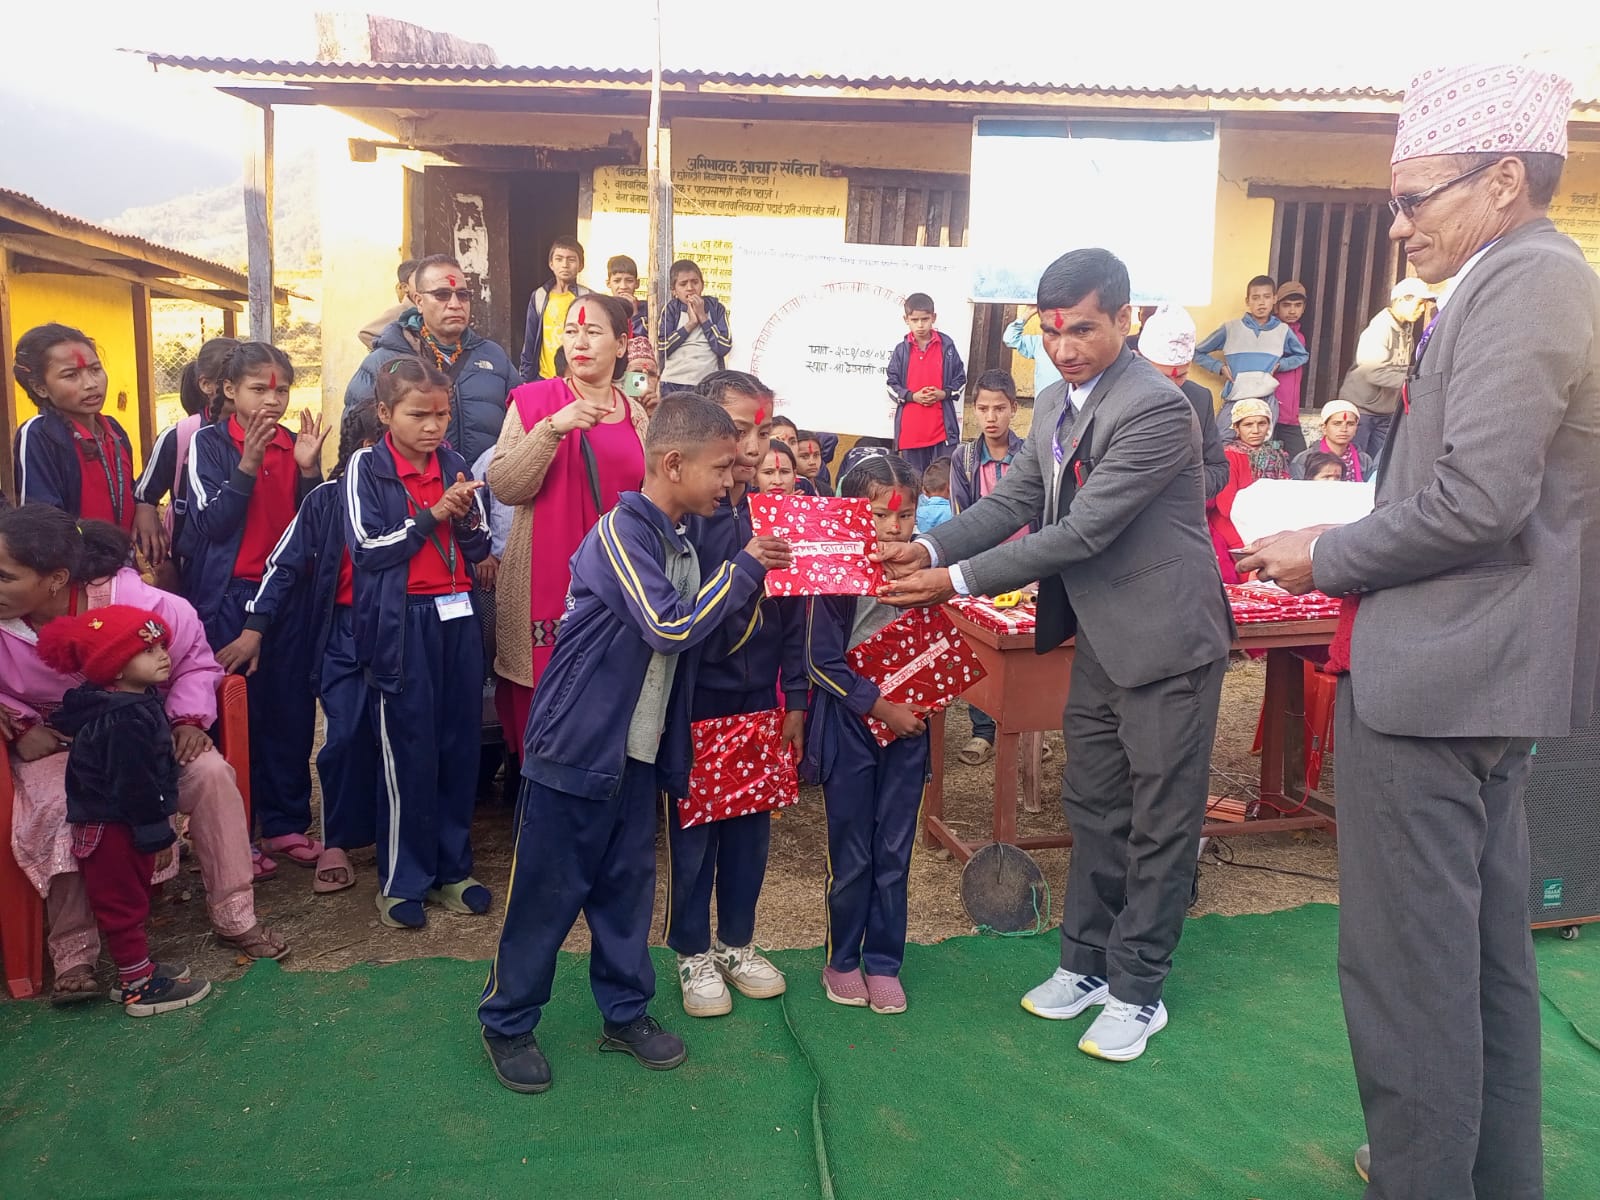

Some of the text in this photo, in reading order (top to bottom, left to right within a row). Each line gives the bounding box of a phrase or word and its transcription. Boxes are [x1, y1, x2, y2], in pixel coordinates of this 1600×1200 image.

[687, 154, 818, 177] अभिभावक आचार संहिता
